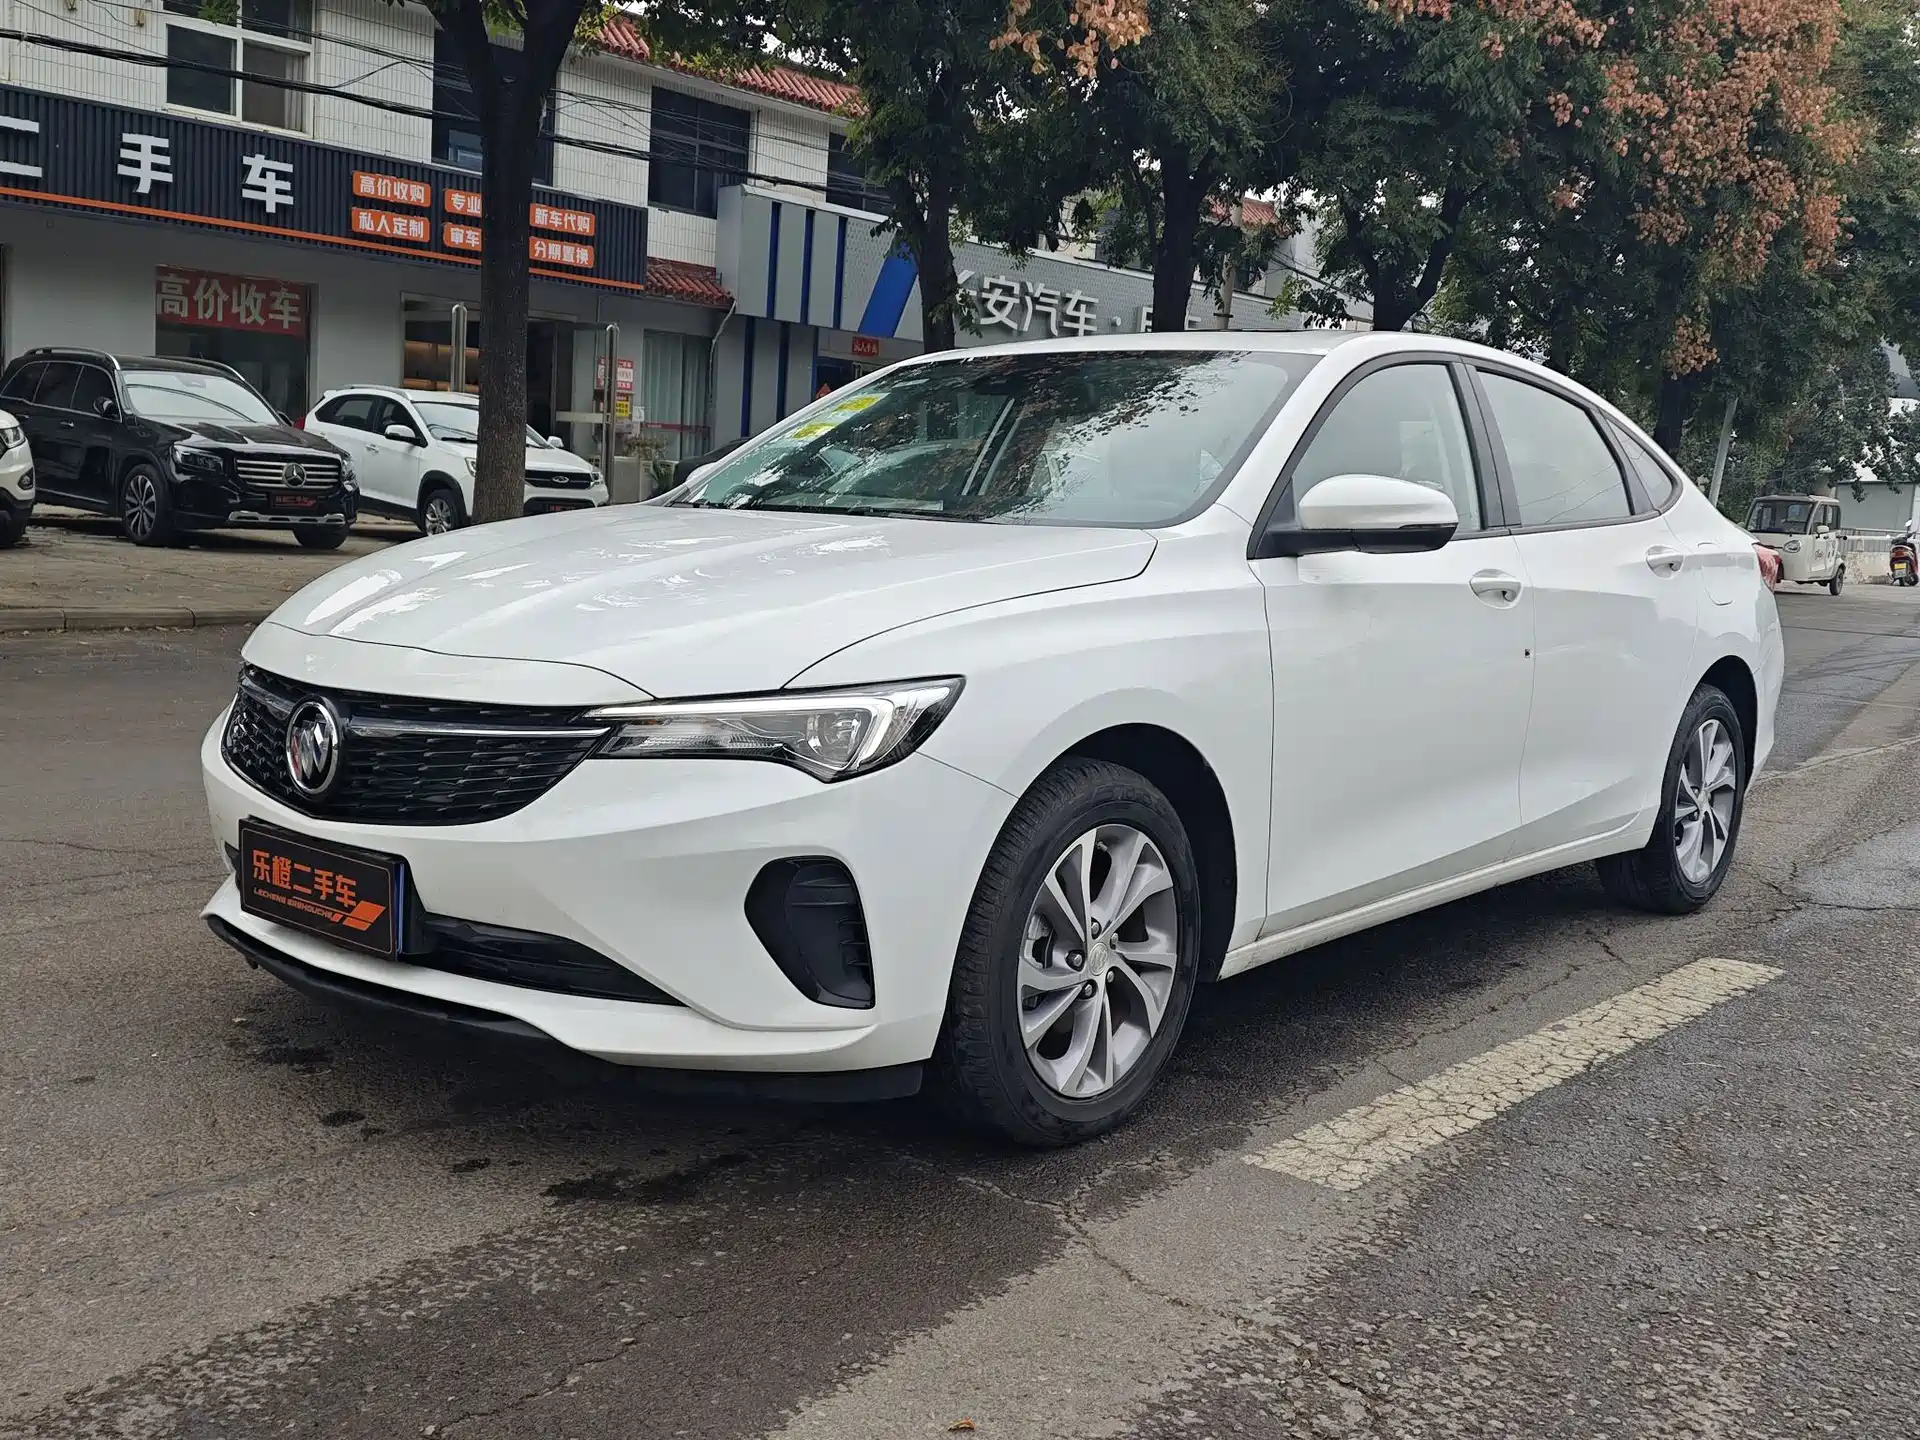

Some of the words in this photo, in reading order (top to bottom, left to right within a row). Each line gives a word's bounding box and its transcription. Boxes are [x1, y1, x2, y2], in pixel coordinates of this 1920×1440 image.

[0, 115, 294, 213] 二手车
[359, 175, 425, 203] 高价收购
[358, 211, 424, 238] 私人定制
[535, 208, 590, 233] 新车代购
[534, 240, 589, 265] 分期置换
[155, 272, 301, 330] 高价收车
[252, 849, 357, 908] 乐橙二手车
